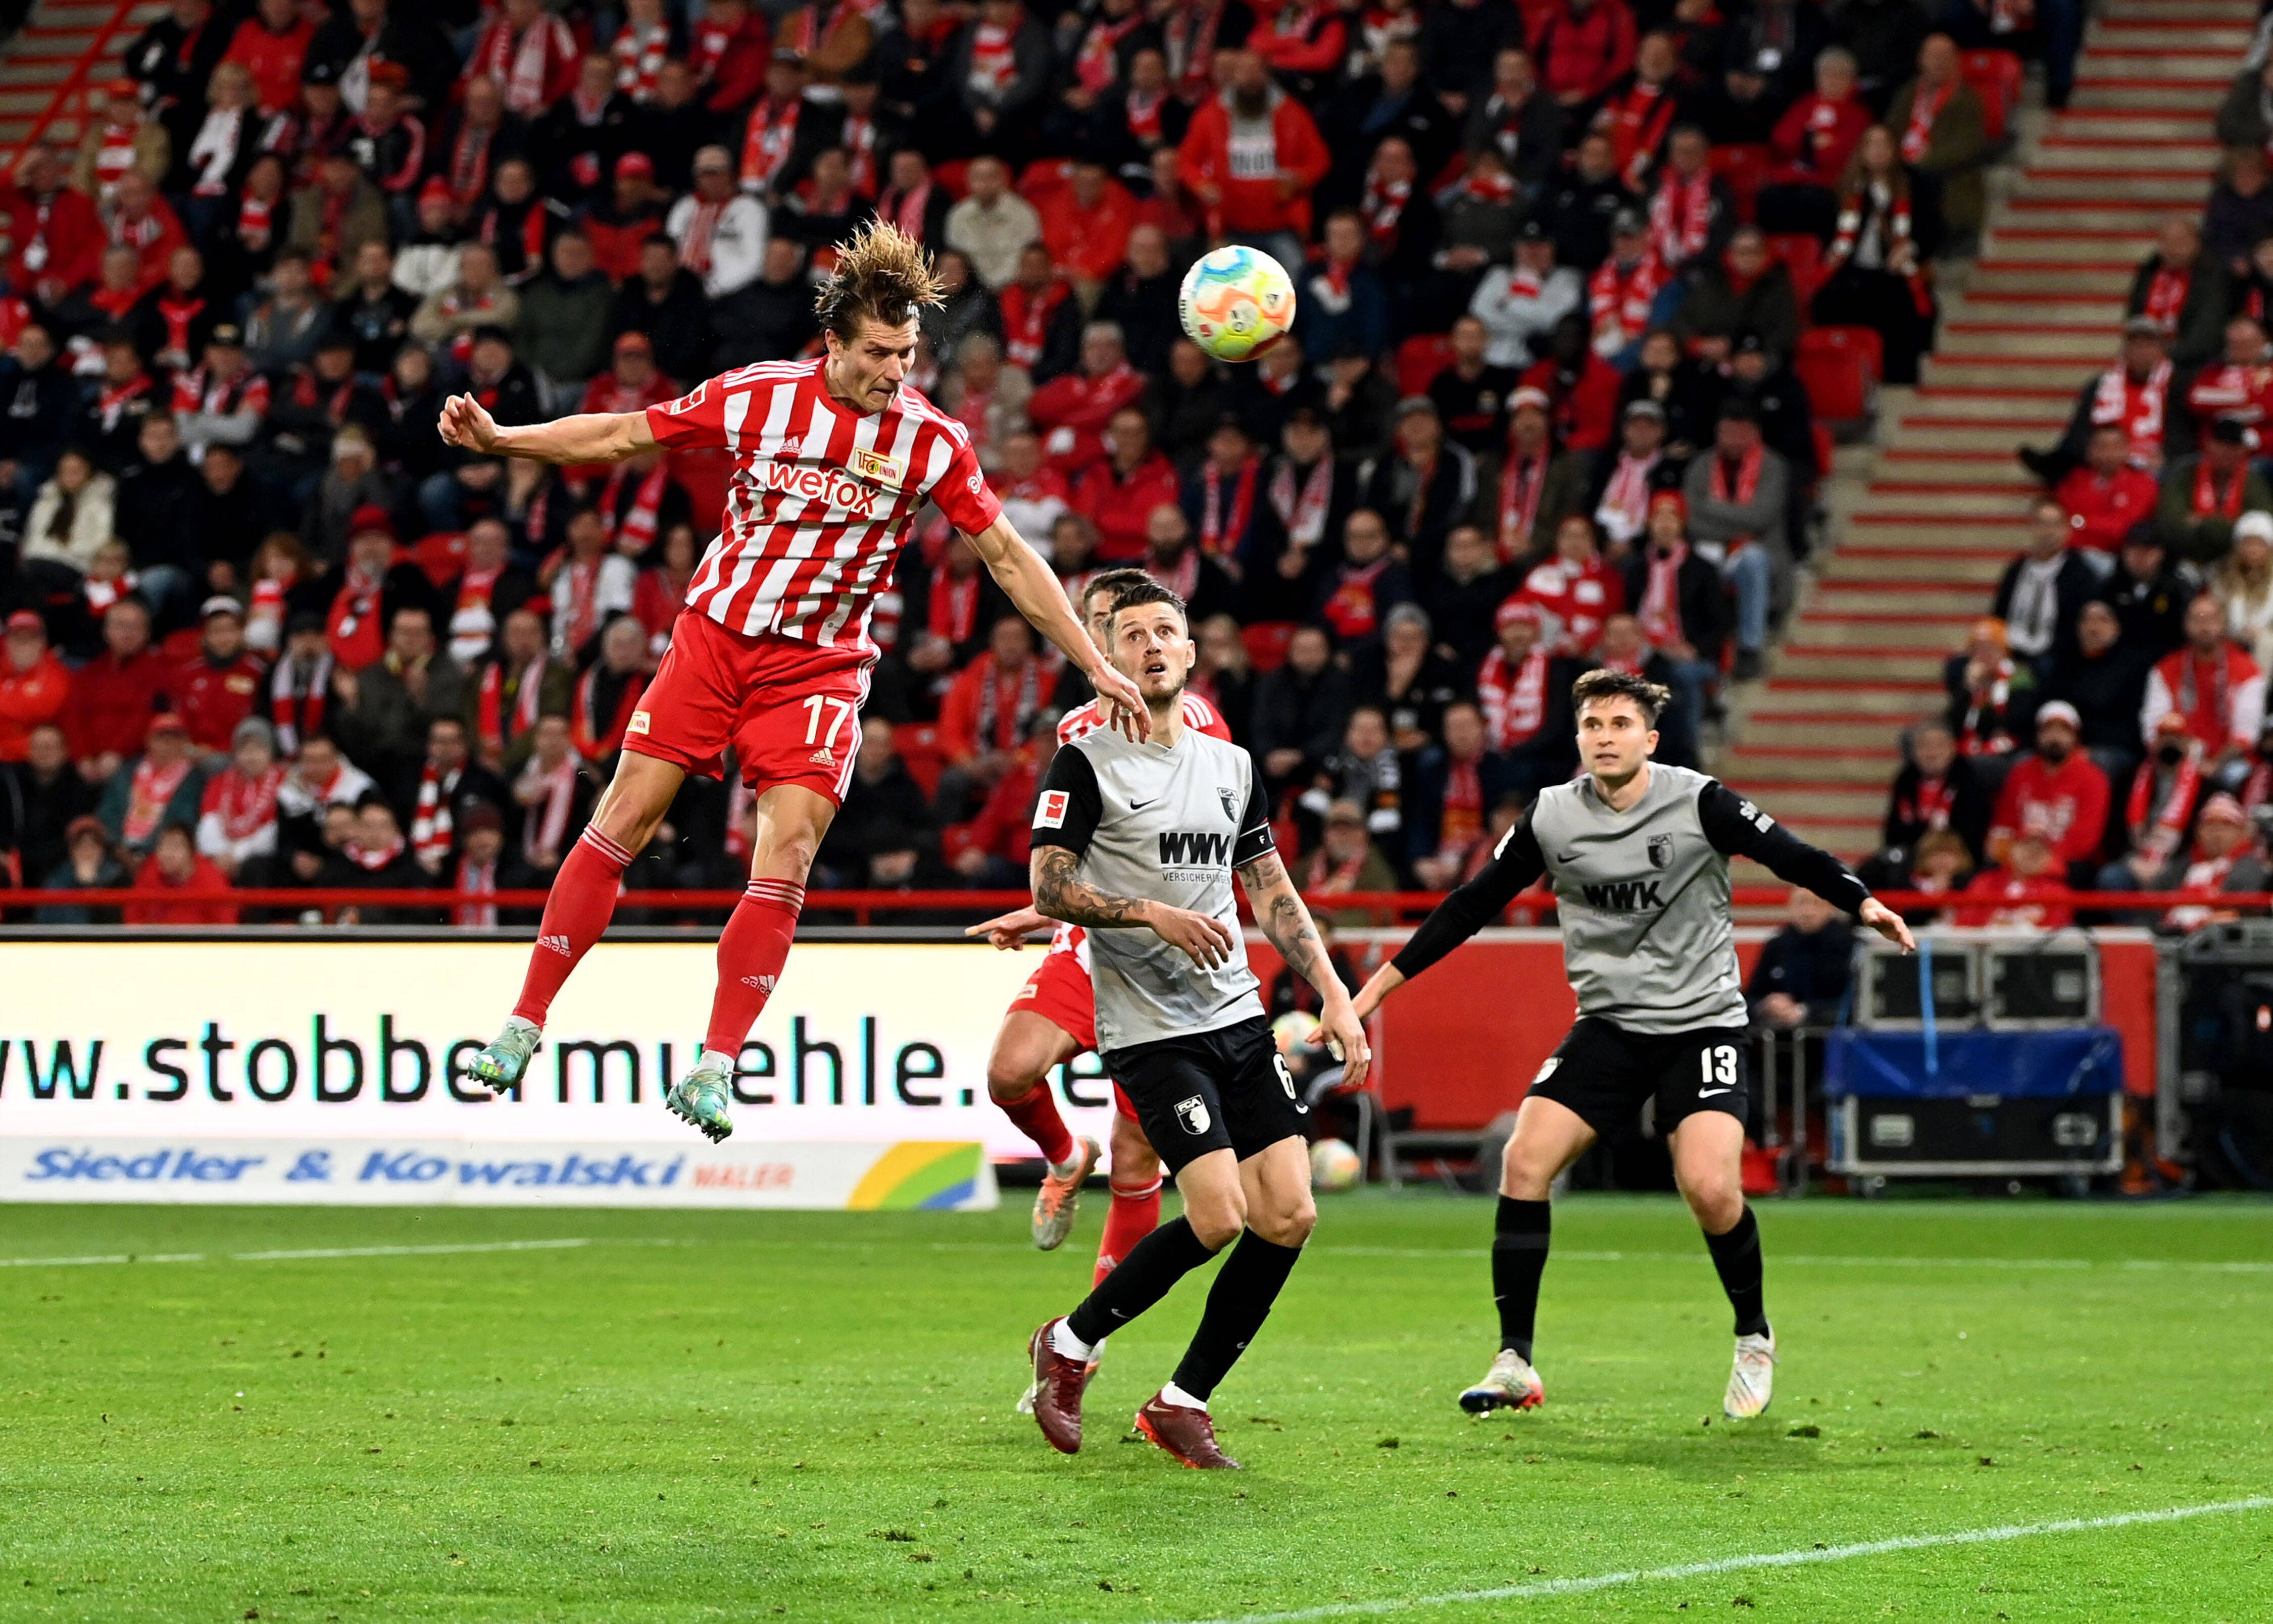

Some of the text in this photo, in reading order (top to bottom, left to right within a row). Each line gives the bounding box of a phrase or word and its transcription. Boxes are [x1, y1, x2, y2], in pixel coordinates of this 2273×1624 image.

[779, 445, 803, 454] adidas
[879, 465, 897, 480] UNION
[769, 463, 881, 515] wefox
[803, 694, 851, 748] 17
[809, 757, 836, 768] adidas
[1159, 832, 1231, 867] WWK
[1582, 880, 1665, 909] WWK
[537, 938, 572, 957] adidas
[740, 977, 771, 998] adida
[1273, 1053, 1297, 1100] 6
[1701, 1045, 1737, 1085] 13
[1177, 1098, 1201, 1112] FCA
[26, 1149, 795, 1189] Siedler & Kowalski MALER
